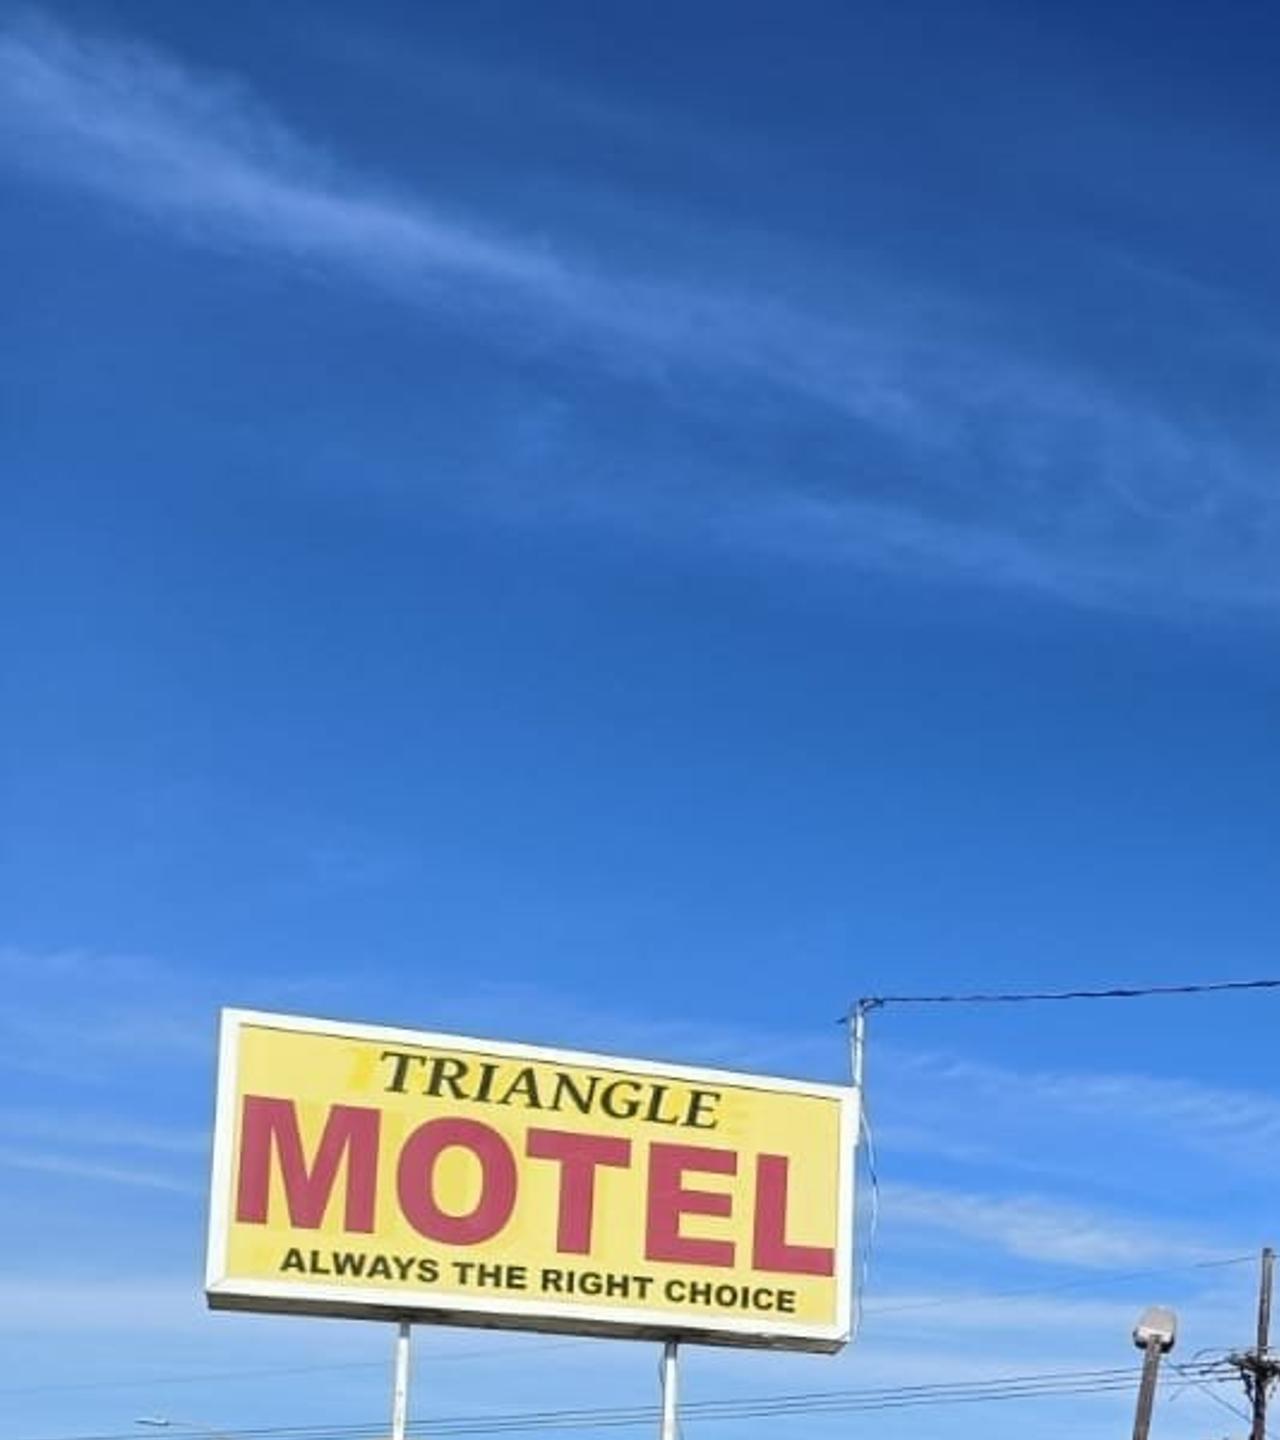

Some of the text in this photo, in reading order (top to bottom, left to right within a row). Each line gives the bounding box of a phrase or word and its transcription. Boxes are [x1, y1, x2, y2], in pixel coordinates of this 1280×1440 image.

[381, 1051, 722, 1130] TRIANGLE
[235, 1093, 836, 1277] MOTEL
[279, 1248, 797, 1314] ALWAYS THE RIGHT CHOICE
